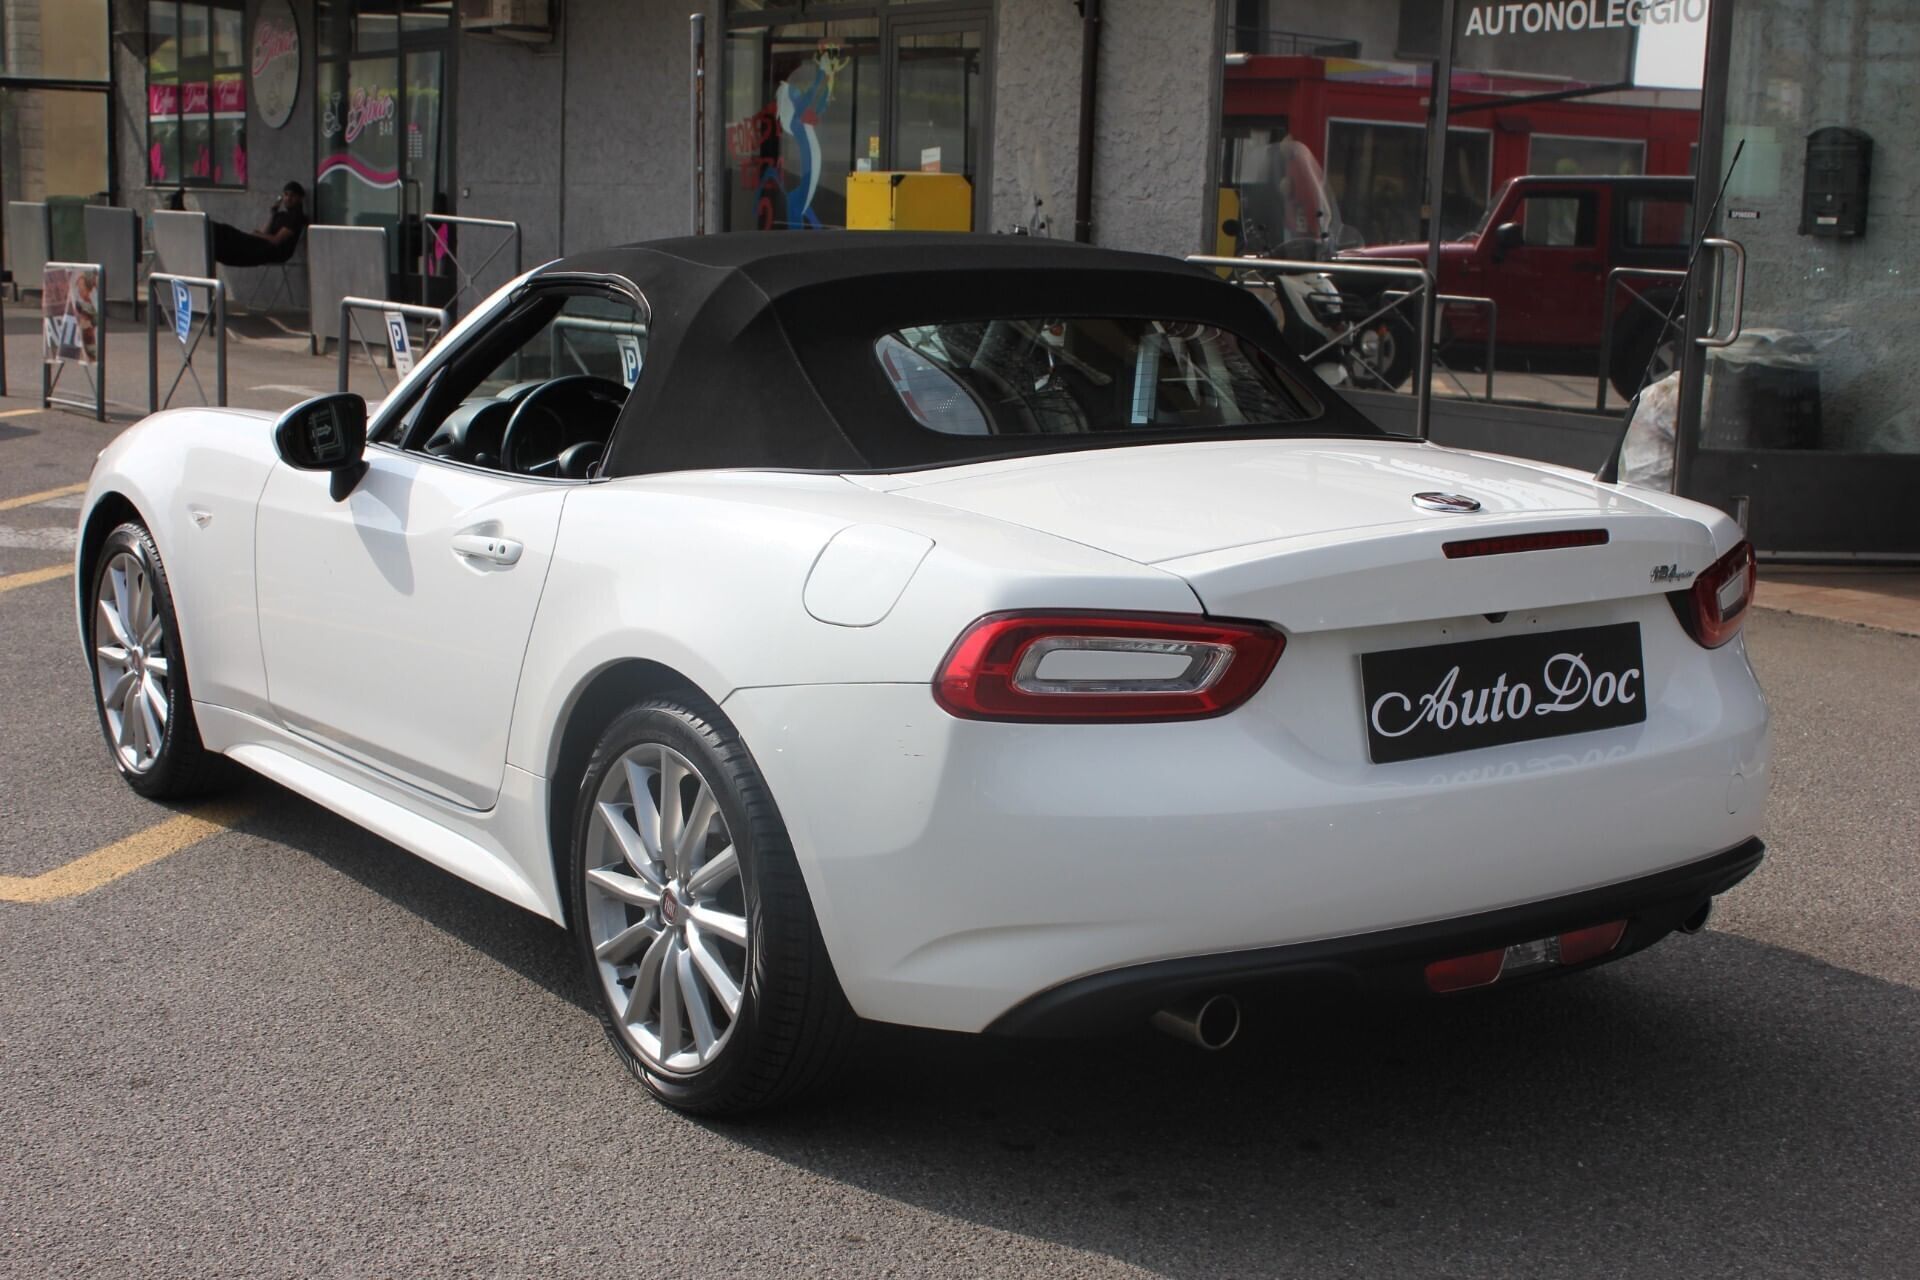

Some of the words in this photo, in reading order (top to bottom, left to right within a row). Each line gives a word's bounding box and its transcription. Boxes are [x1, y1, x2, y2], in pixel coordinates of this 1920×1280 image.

[1465, 0, 1706, 36] AUTONOLEGGIO
[176, 286, 188, 309] P
[391, 324, 402, 350] P
[625, 350, 636, 380] P
[1371, 666, 1532, 737] Auto
[1534, 652, 1640, 716] Doc
